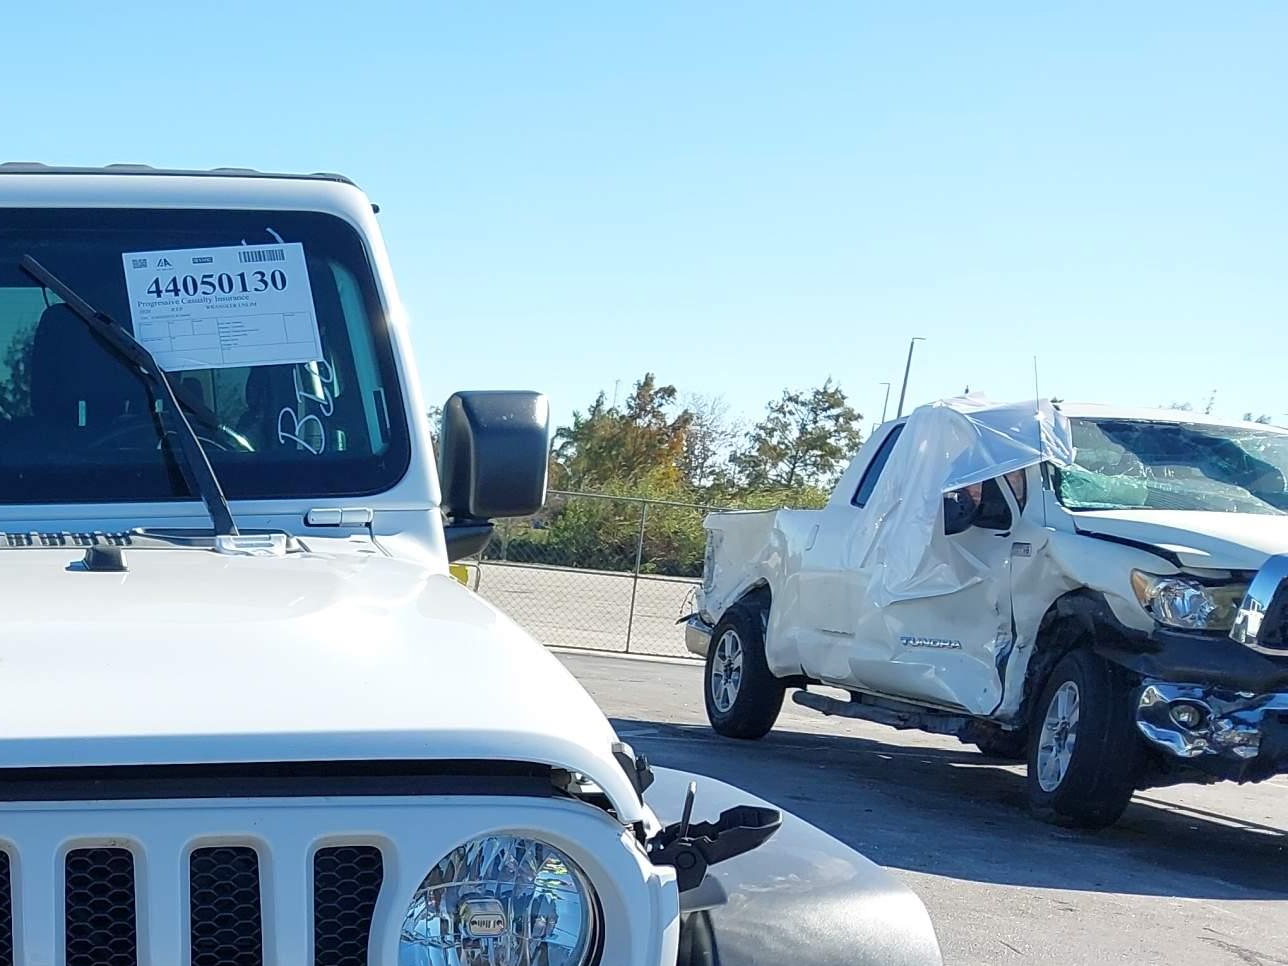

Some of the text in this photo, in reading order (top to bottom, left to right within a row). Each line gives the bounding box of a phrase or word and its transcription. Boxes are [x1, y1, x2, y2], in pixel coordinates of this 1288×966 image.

[146, 269, 288, 299] 44050130
[138, 295, 250, 308] Progressive Casualty Insurance
[900, 636, 962, 650] TUNDRA
